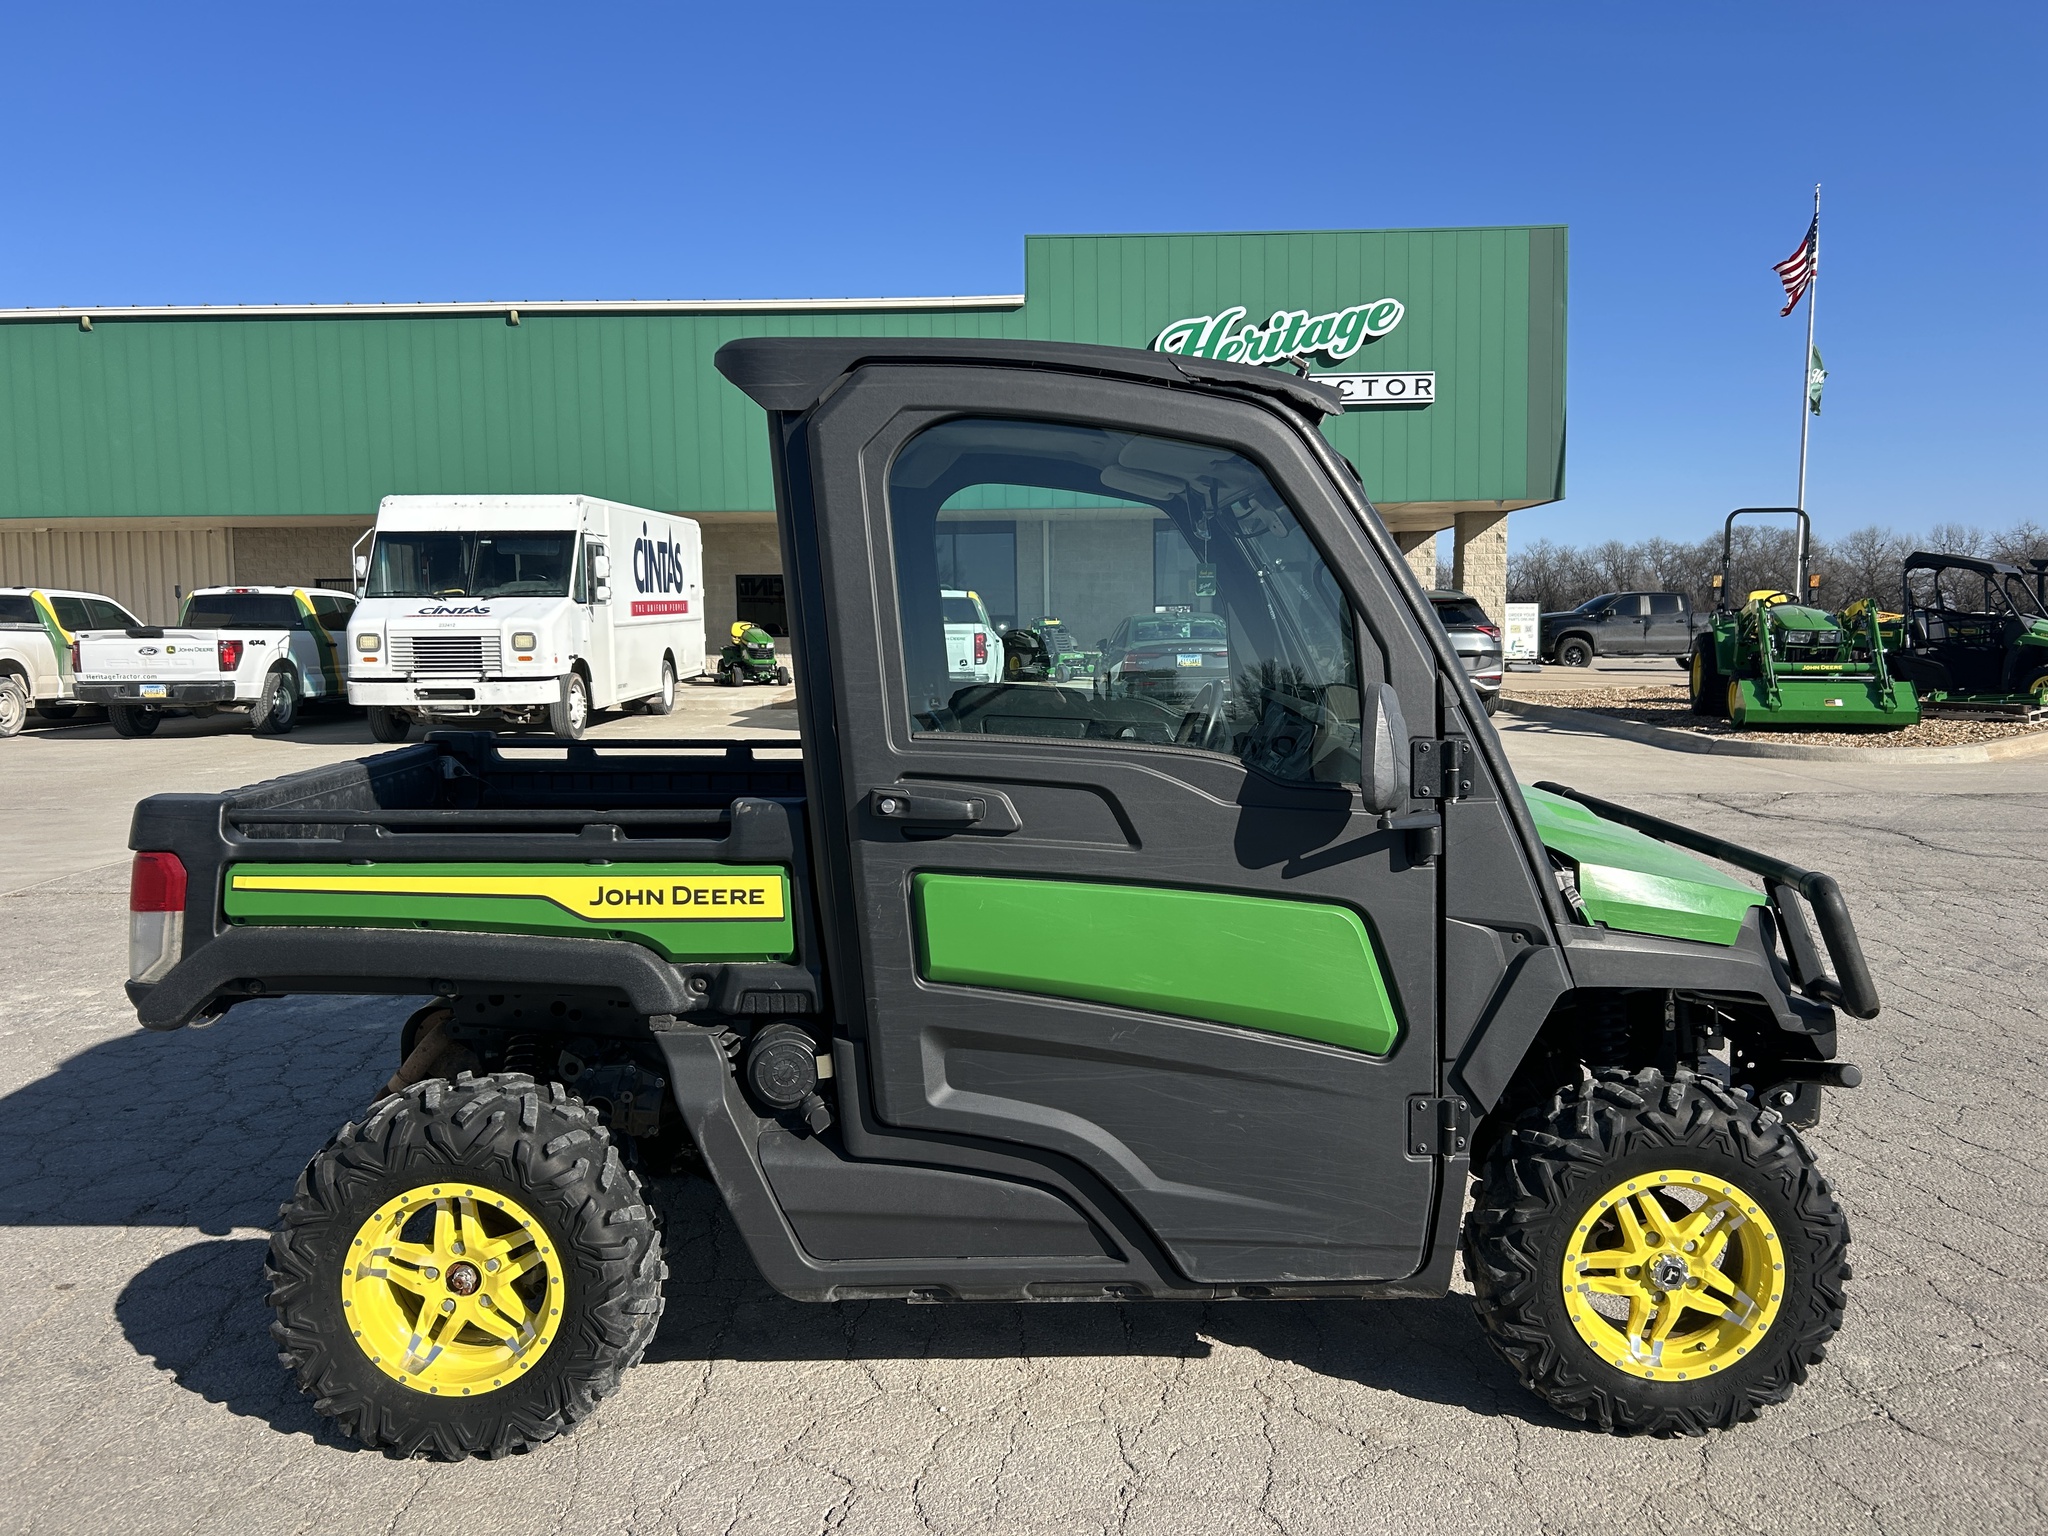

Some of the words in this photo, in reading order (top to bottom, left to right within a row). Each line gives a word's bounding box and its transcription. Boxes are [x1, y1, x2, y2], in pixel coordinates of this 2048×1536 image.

[1155, 298, 1405, 366] Heritage
[1318, 378, 1433, 398] CTOR
[590, 886, 664, 906] JOHN
[672, 886, 764, 905] DEERE
